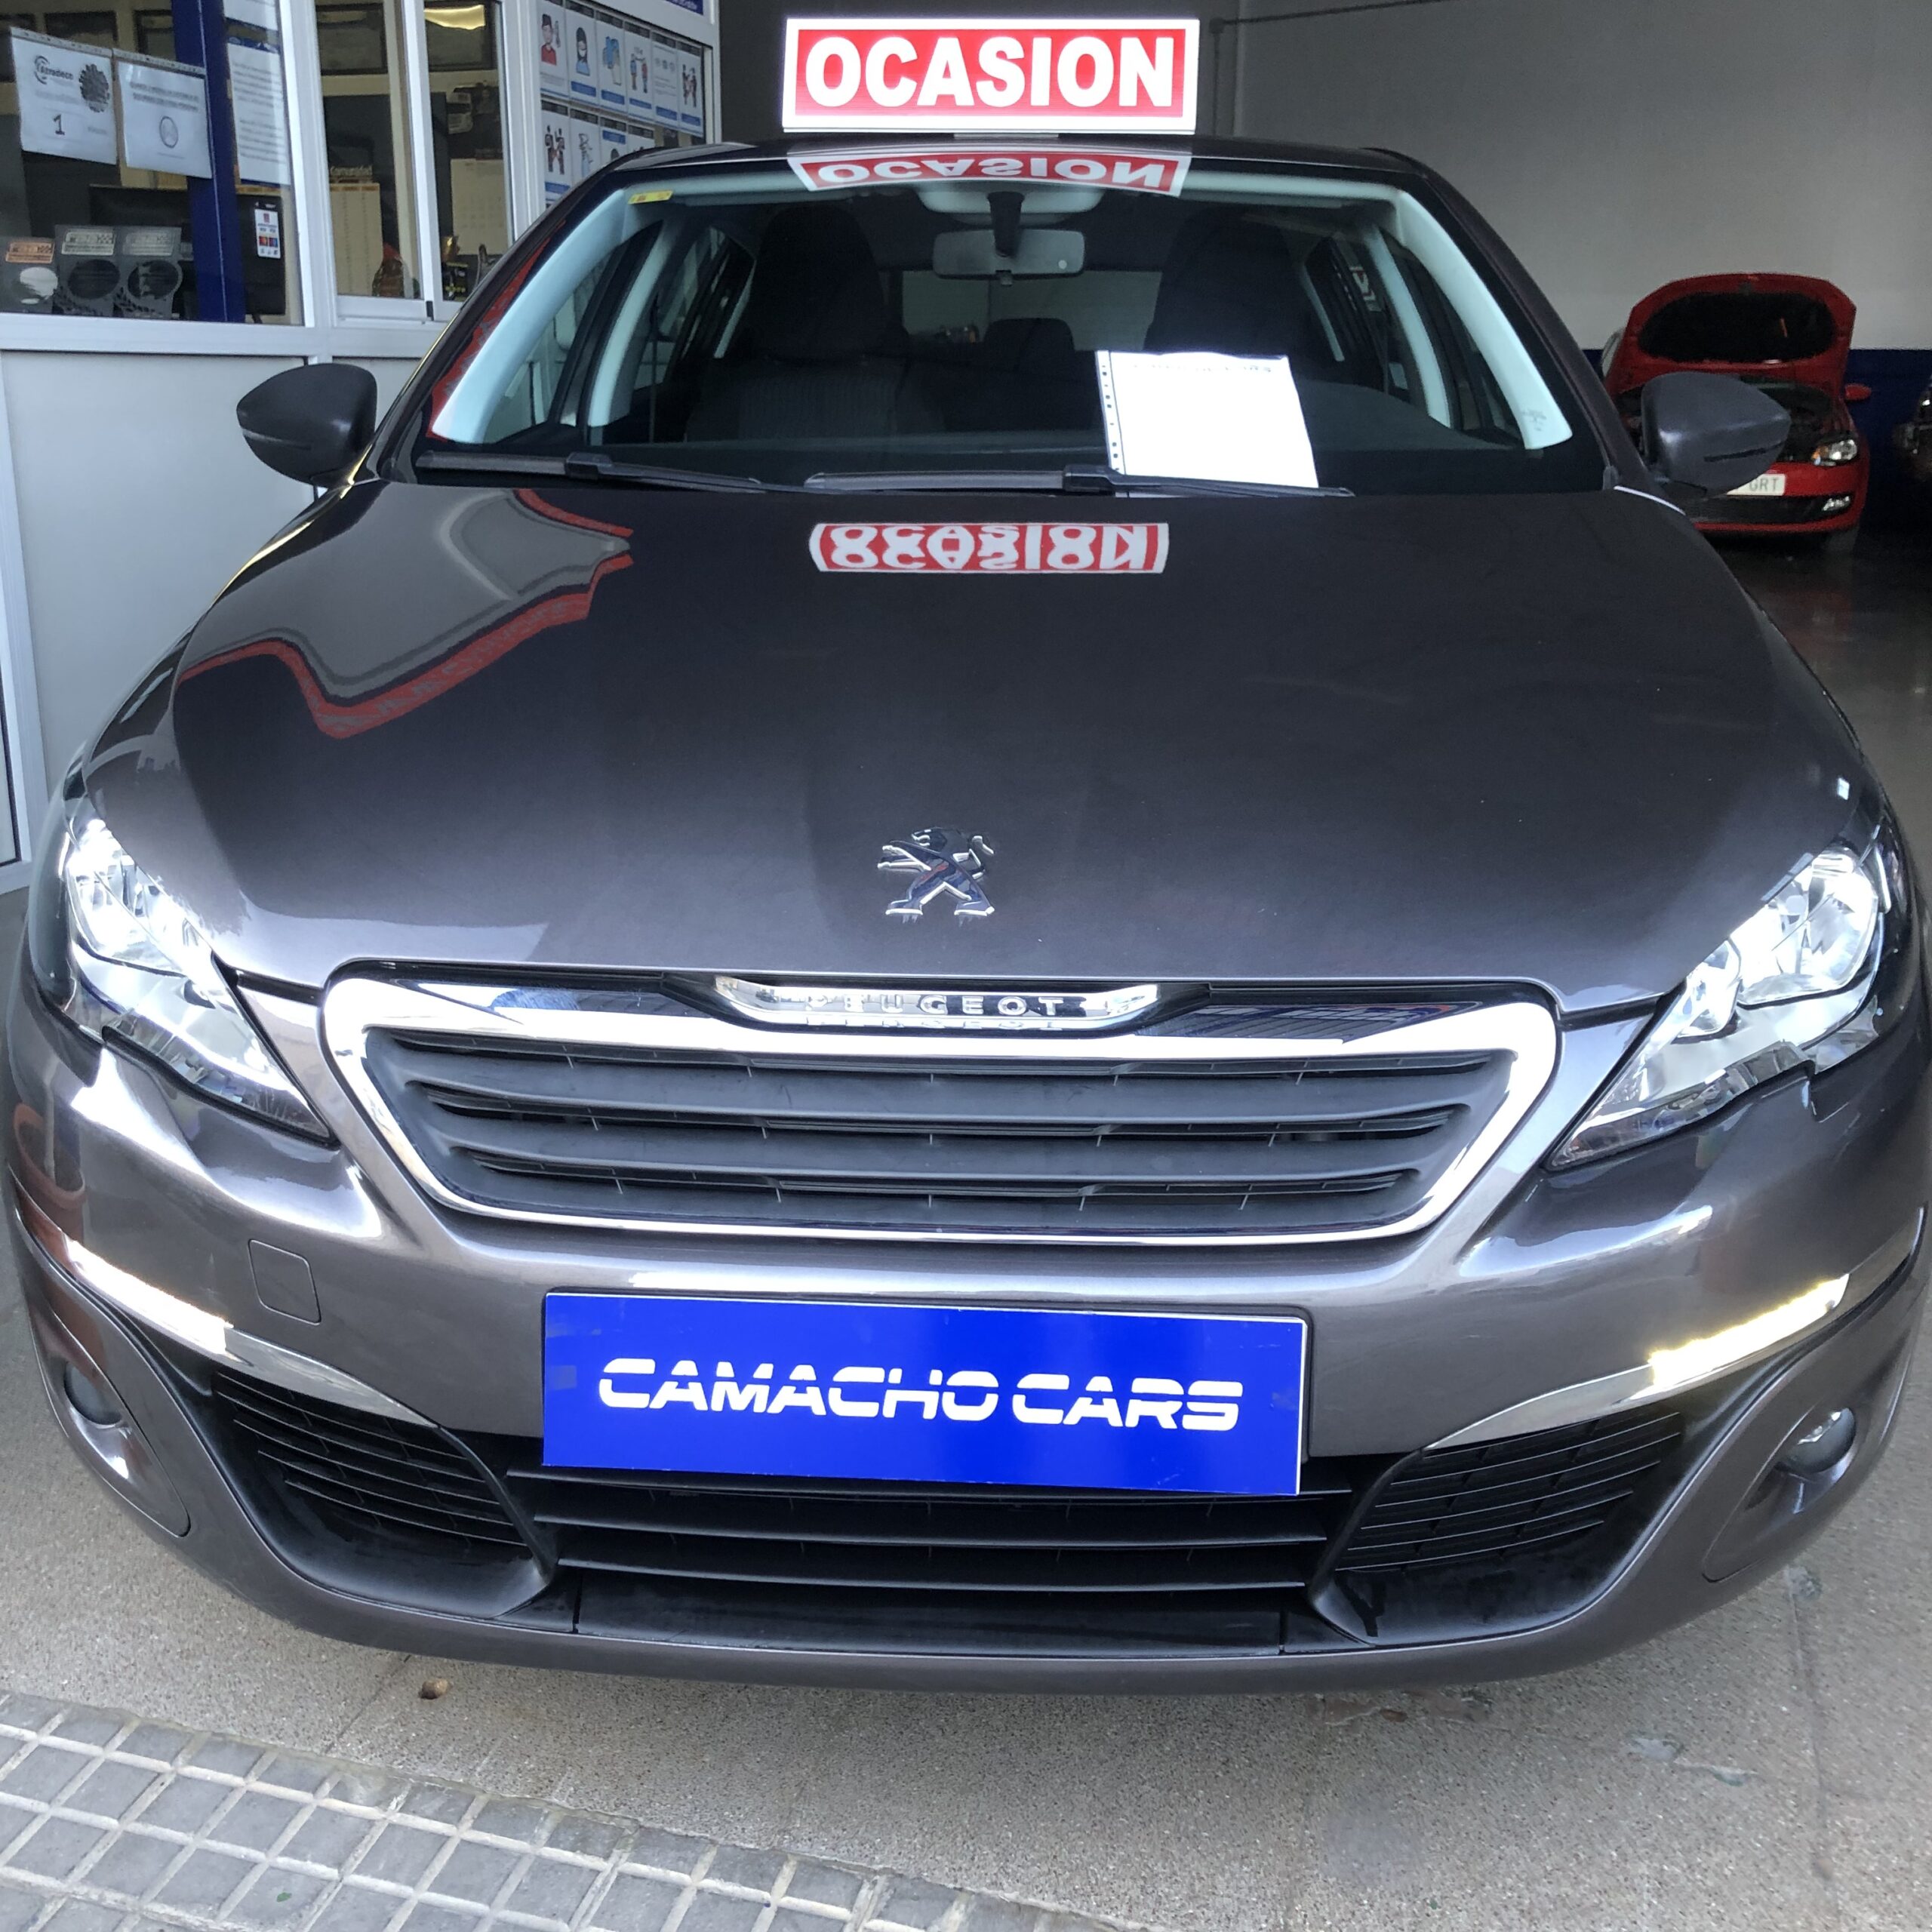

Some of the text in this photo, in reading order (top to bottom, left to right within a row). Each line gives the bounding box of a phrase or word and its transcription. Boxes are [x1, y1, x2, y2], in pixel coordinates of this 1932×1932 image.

[804, 36, 1174, 107] OCASION
[1749, 478, 1778, 492] GRT
[600, 1358, 1244, 1432] CAMACHO CARS
